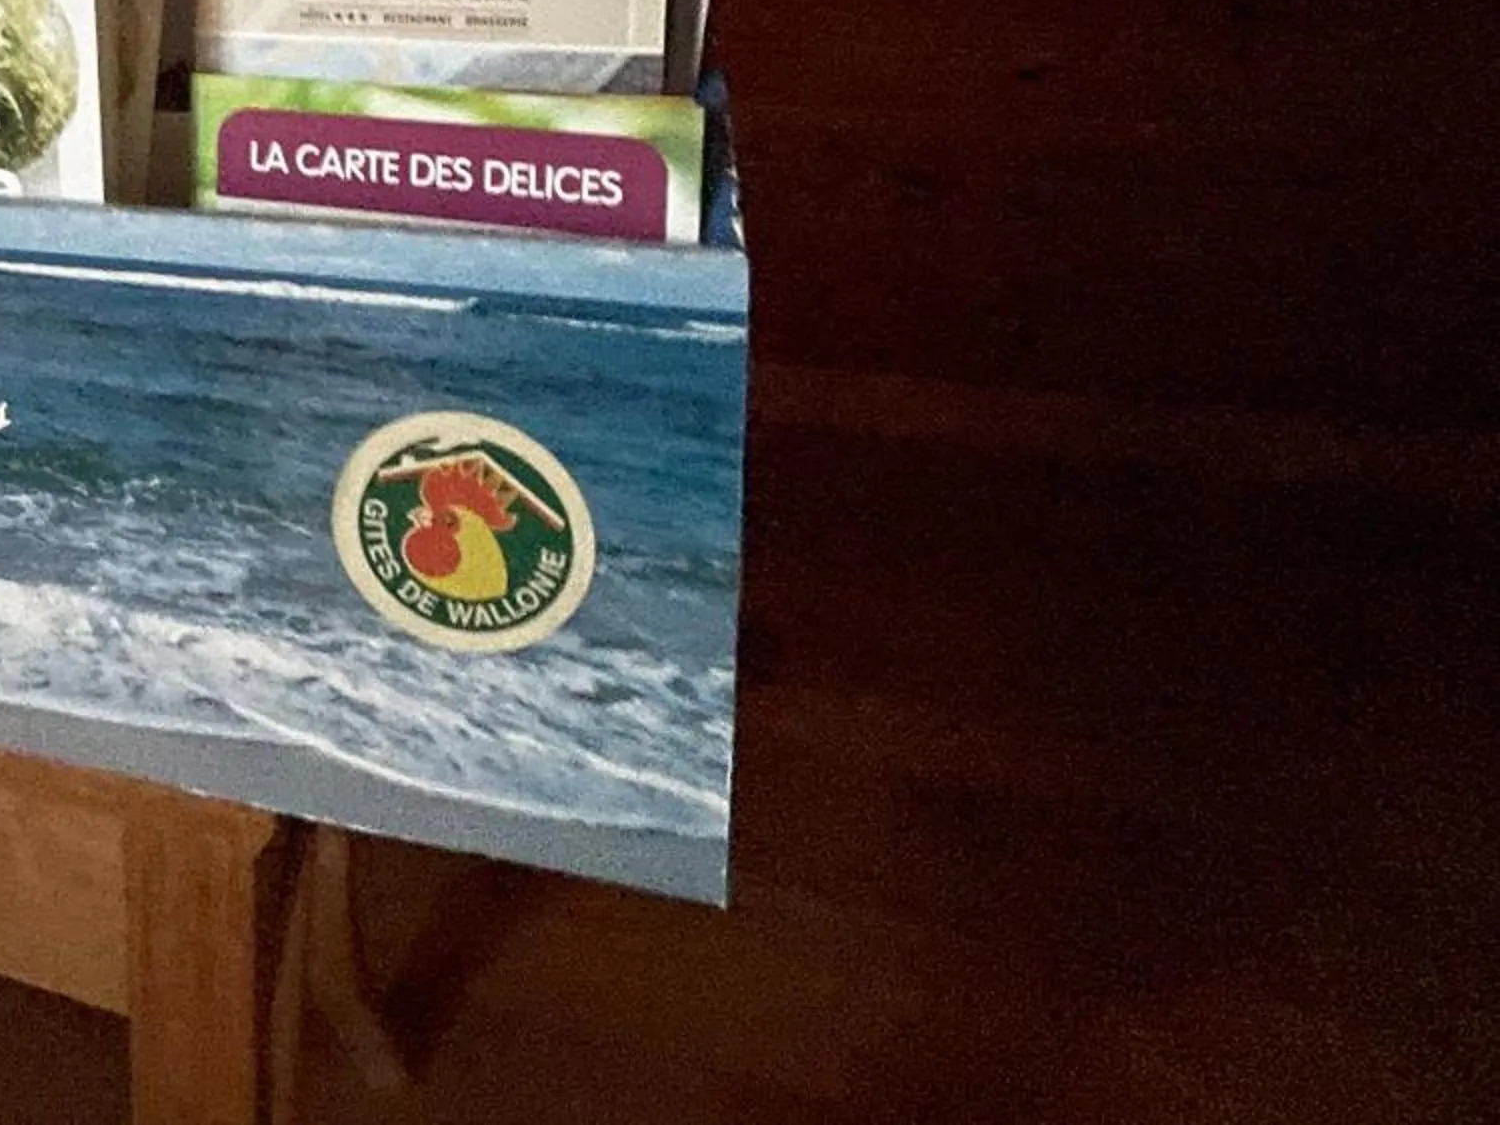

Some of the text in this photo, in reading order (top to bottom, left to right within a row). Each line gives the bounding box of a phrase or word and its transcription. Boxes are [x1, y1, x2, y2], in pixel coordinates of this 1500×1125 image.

[249, 138, 624, 207] LA CARTE DES DELICES
[398, 583, 442, 618] DE
[446, 546, 567, 628] WALLONIE
